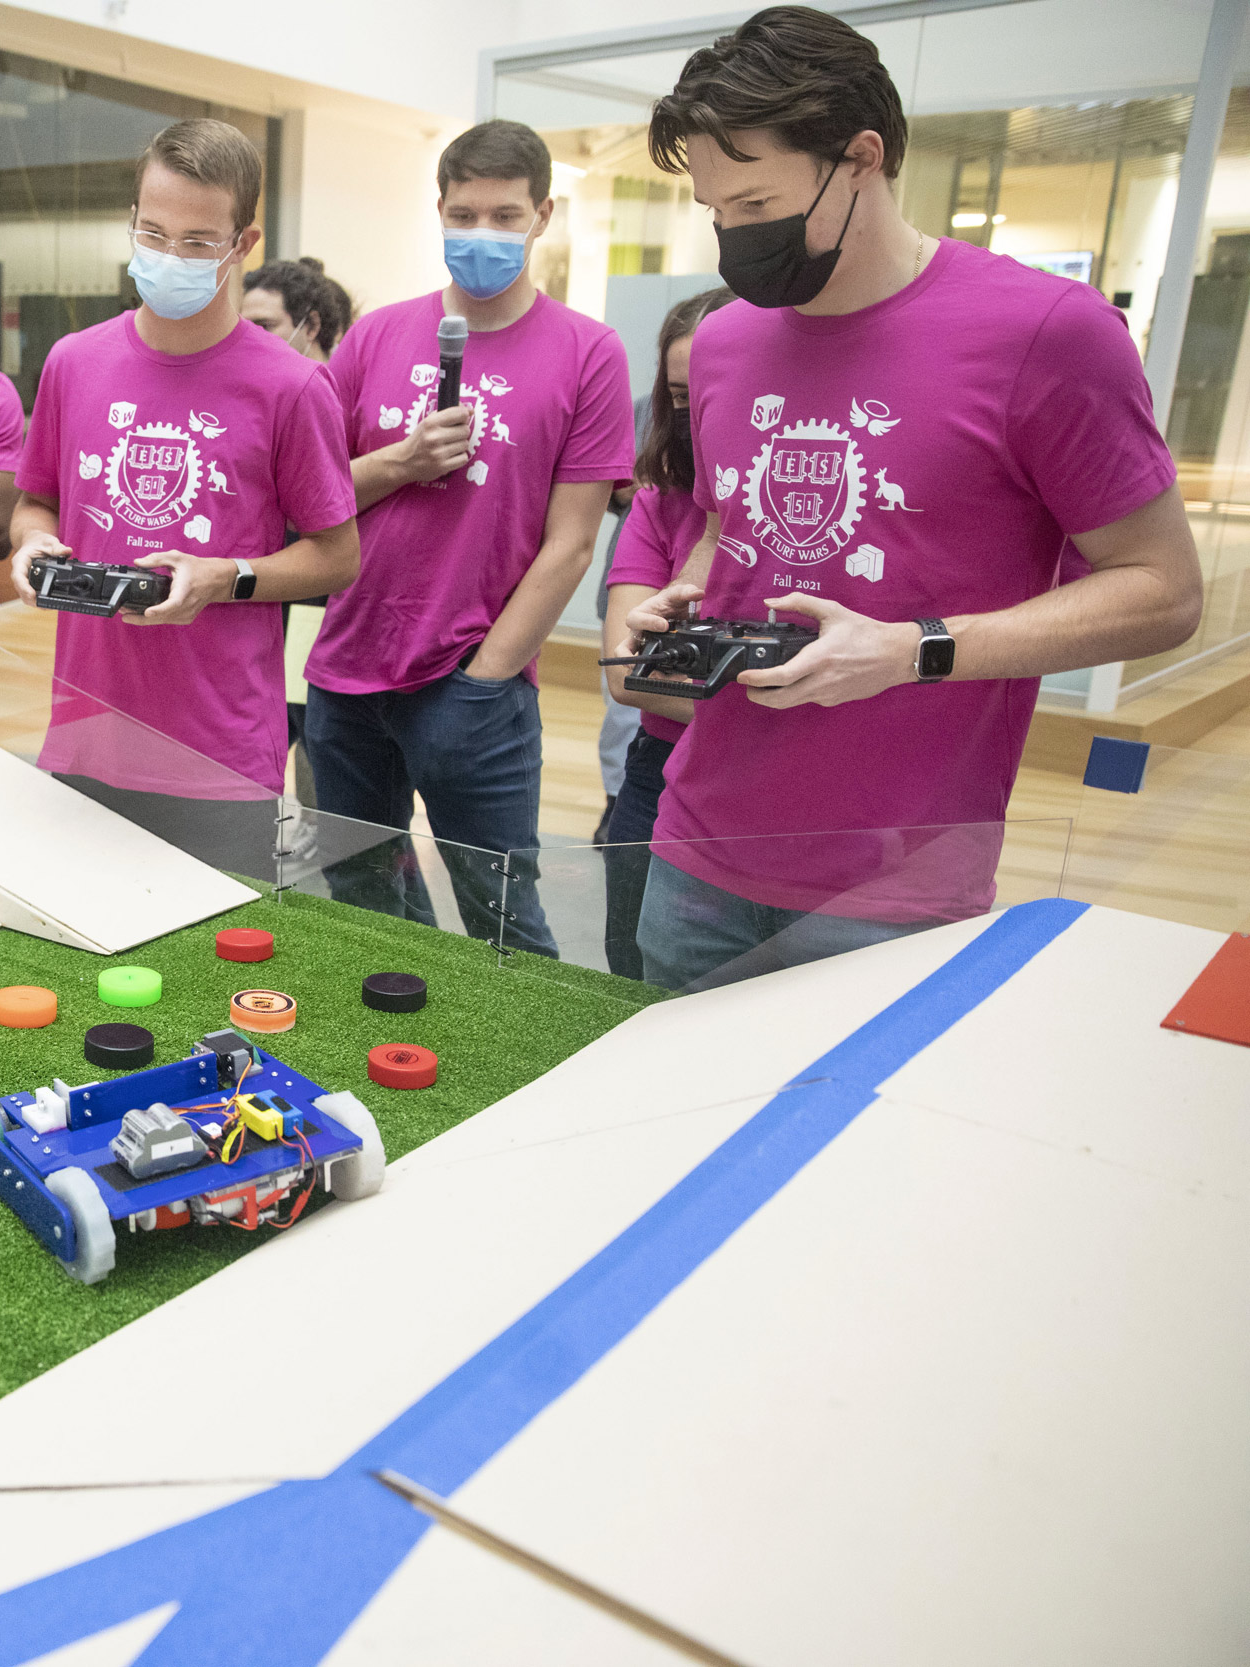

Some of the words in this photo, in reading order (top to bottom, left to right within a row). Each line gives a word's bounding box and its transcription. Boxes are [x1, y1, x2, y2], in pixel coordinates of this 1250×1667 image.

[785, 458, 796, 473] E
[123, 506, 146, 526] TURF
[147, 513, 172, 526] WARS
[126, 535, 143, 547] Fall
[144, 540, 163, 549] 2021
[770, 535, 796, 559] TURF
[798, 543, 830, 561] WARS
[773, 573, 792, 588] Fall
[795, 579, 821, 591] 2021
